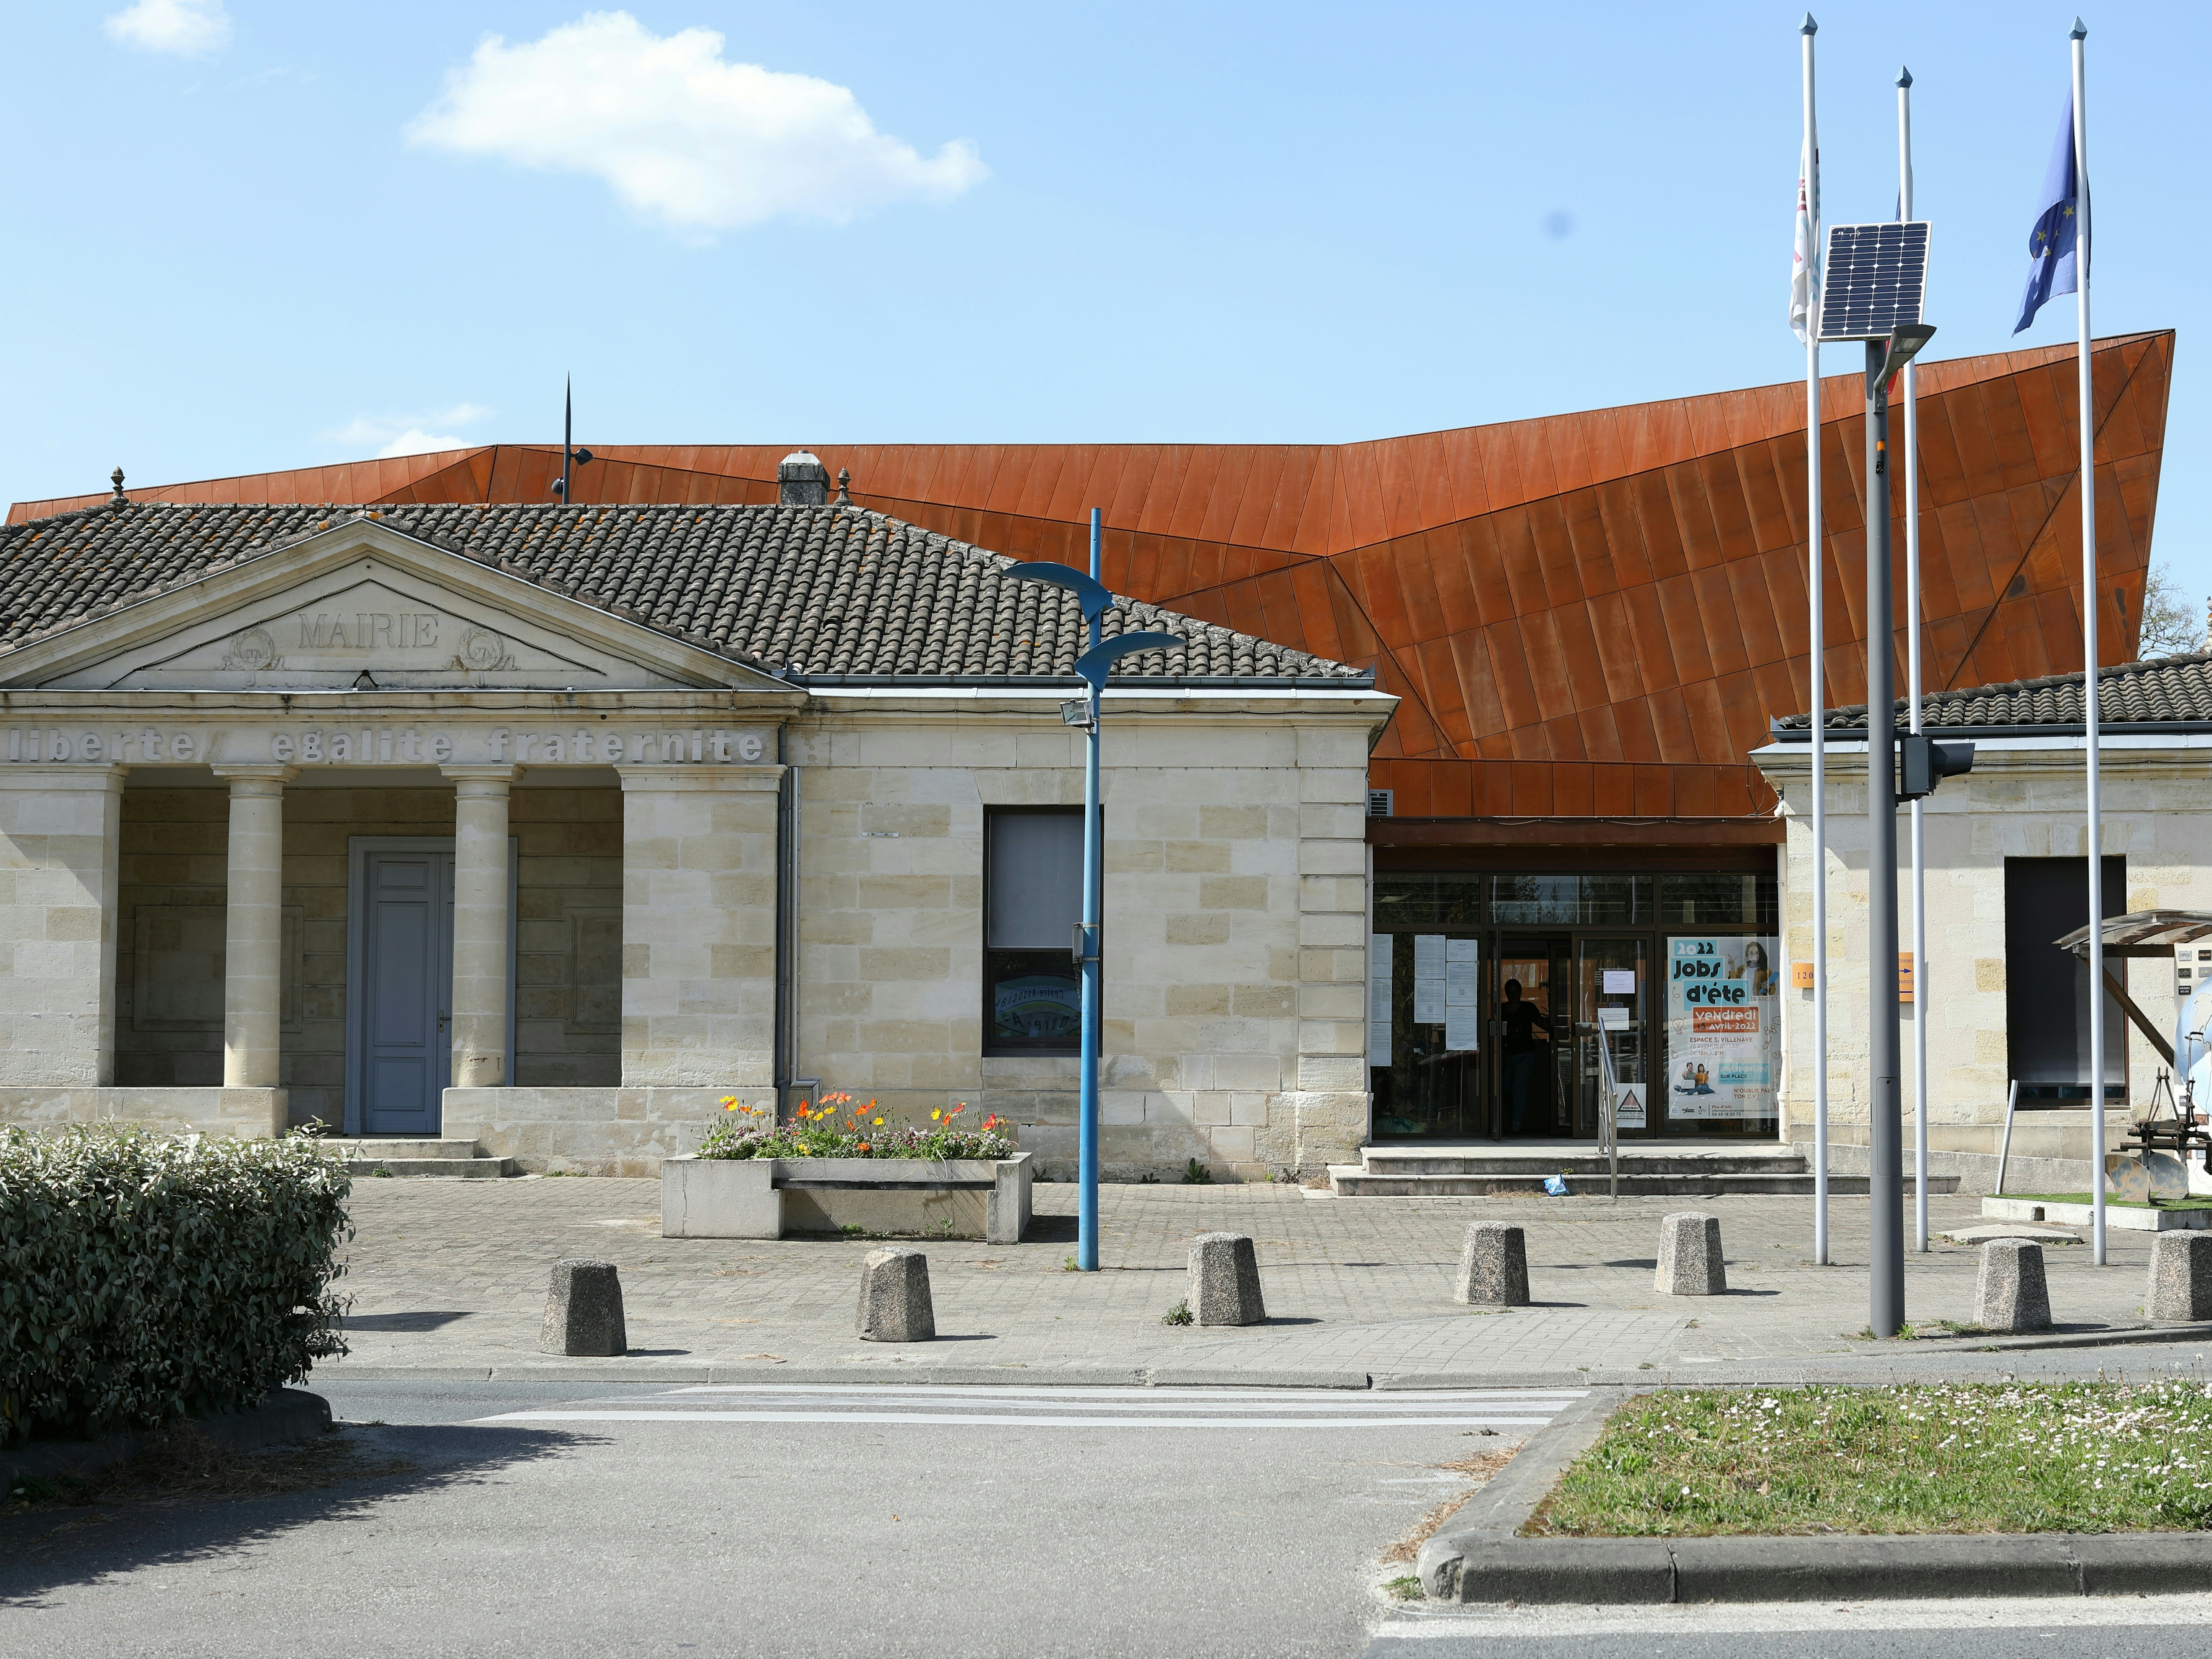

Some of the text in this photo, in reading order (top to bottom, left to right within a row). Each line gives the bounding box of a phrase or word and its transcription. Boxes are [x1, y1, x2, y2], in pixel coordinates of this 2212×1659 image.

[298, 613, 439, 648] MAIRIE
[9, 728, 762, 762] liberte egalite fraternite
[1677, 942, 1714, 955] 2022
[1673, 960, 1721, 979] Jobs
[1686, 982, 1746, 1004] d'été
